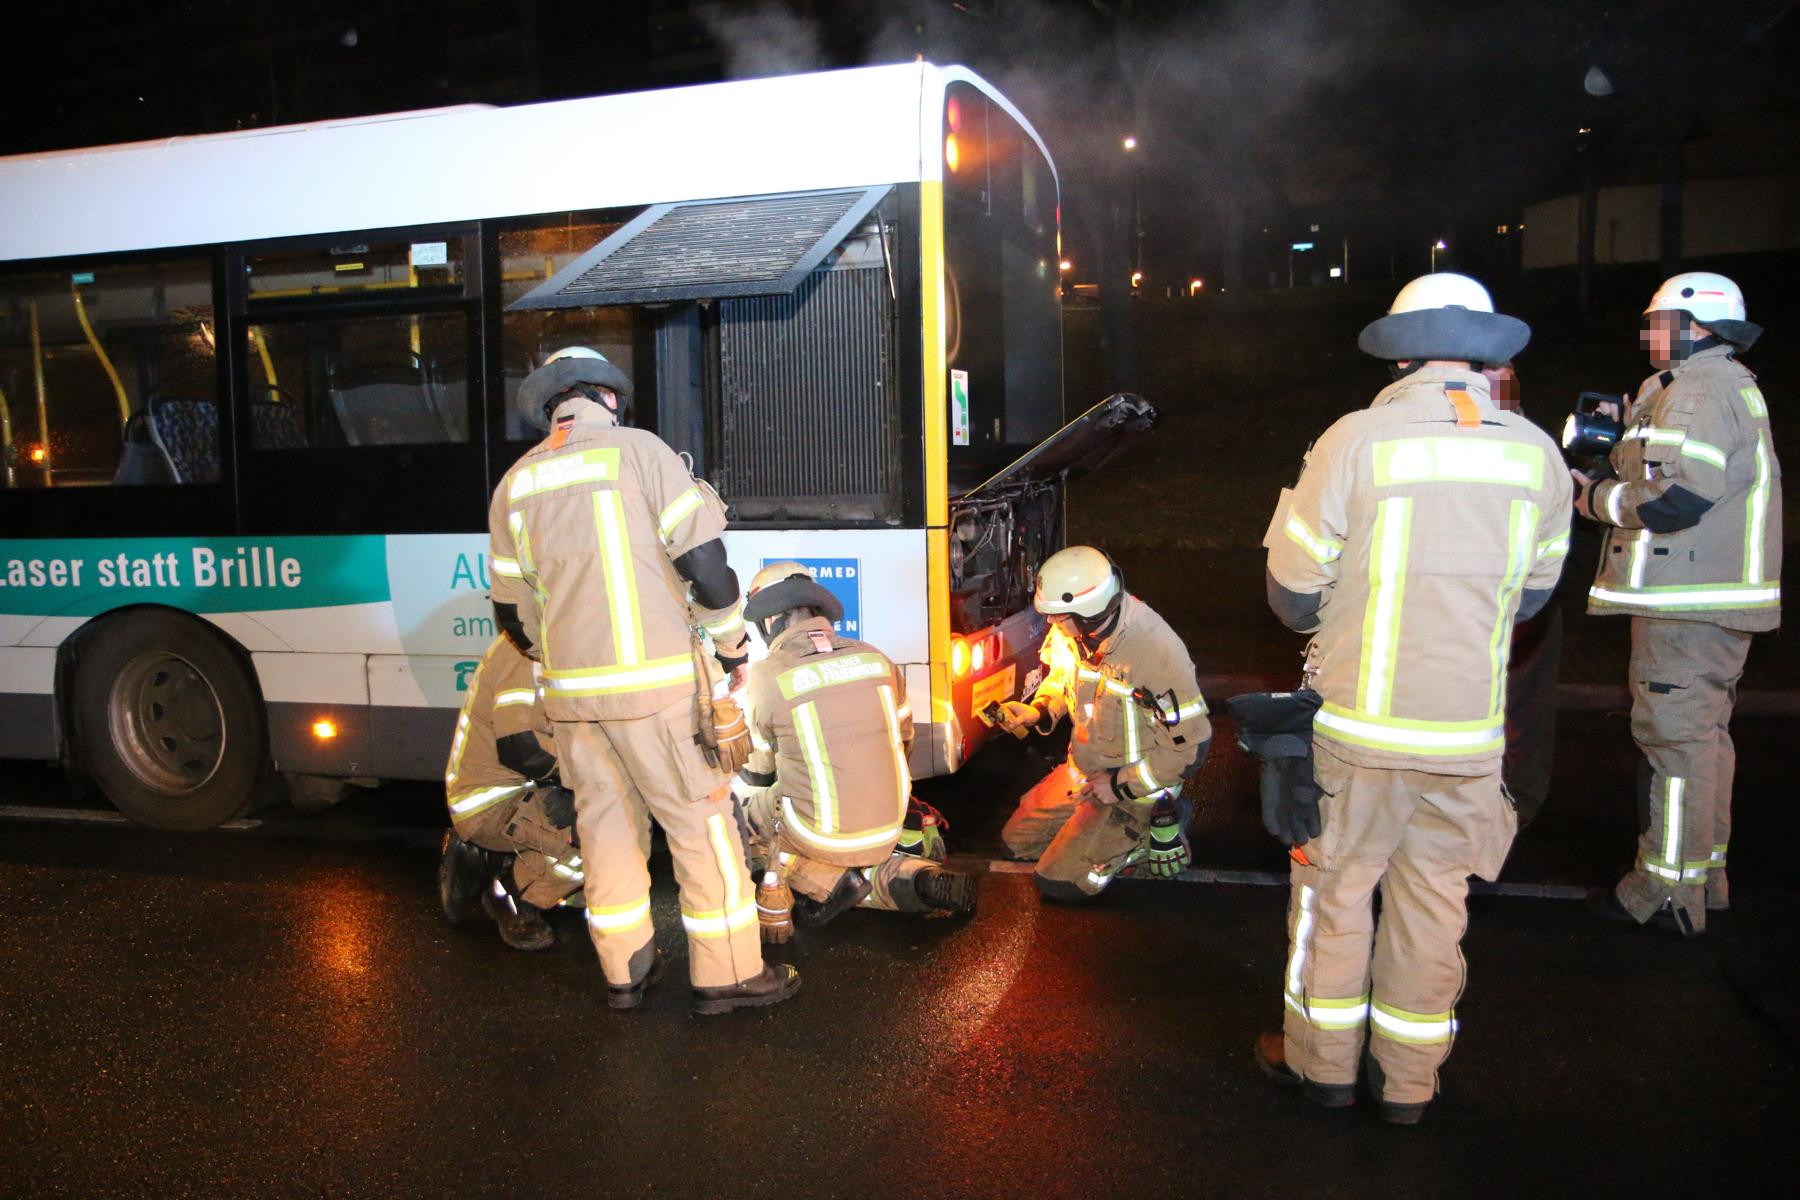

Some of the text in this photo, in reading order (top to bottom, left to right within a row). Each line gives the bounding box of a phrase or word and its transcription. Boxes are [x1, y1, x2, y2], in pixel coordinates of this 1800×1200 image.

[98, 552, 180, 587] statt
[192, 547, 302, 587] Brille
[453, 617, 493, 637] am
